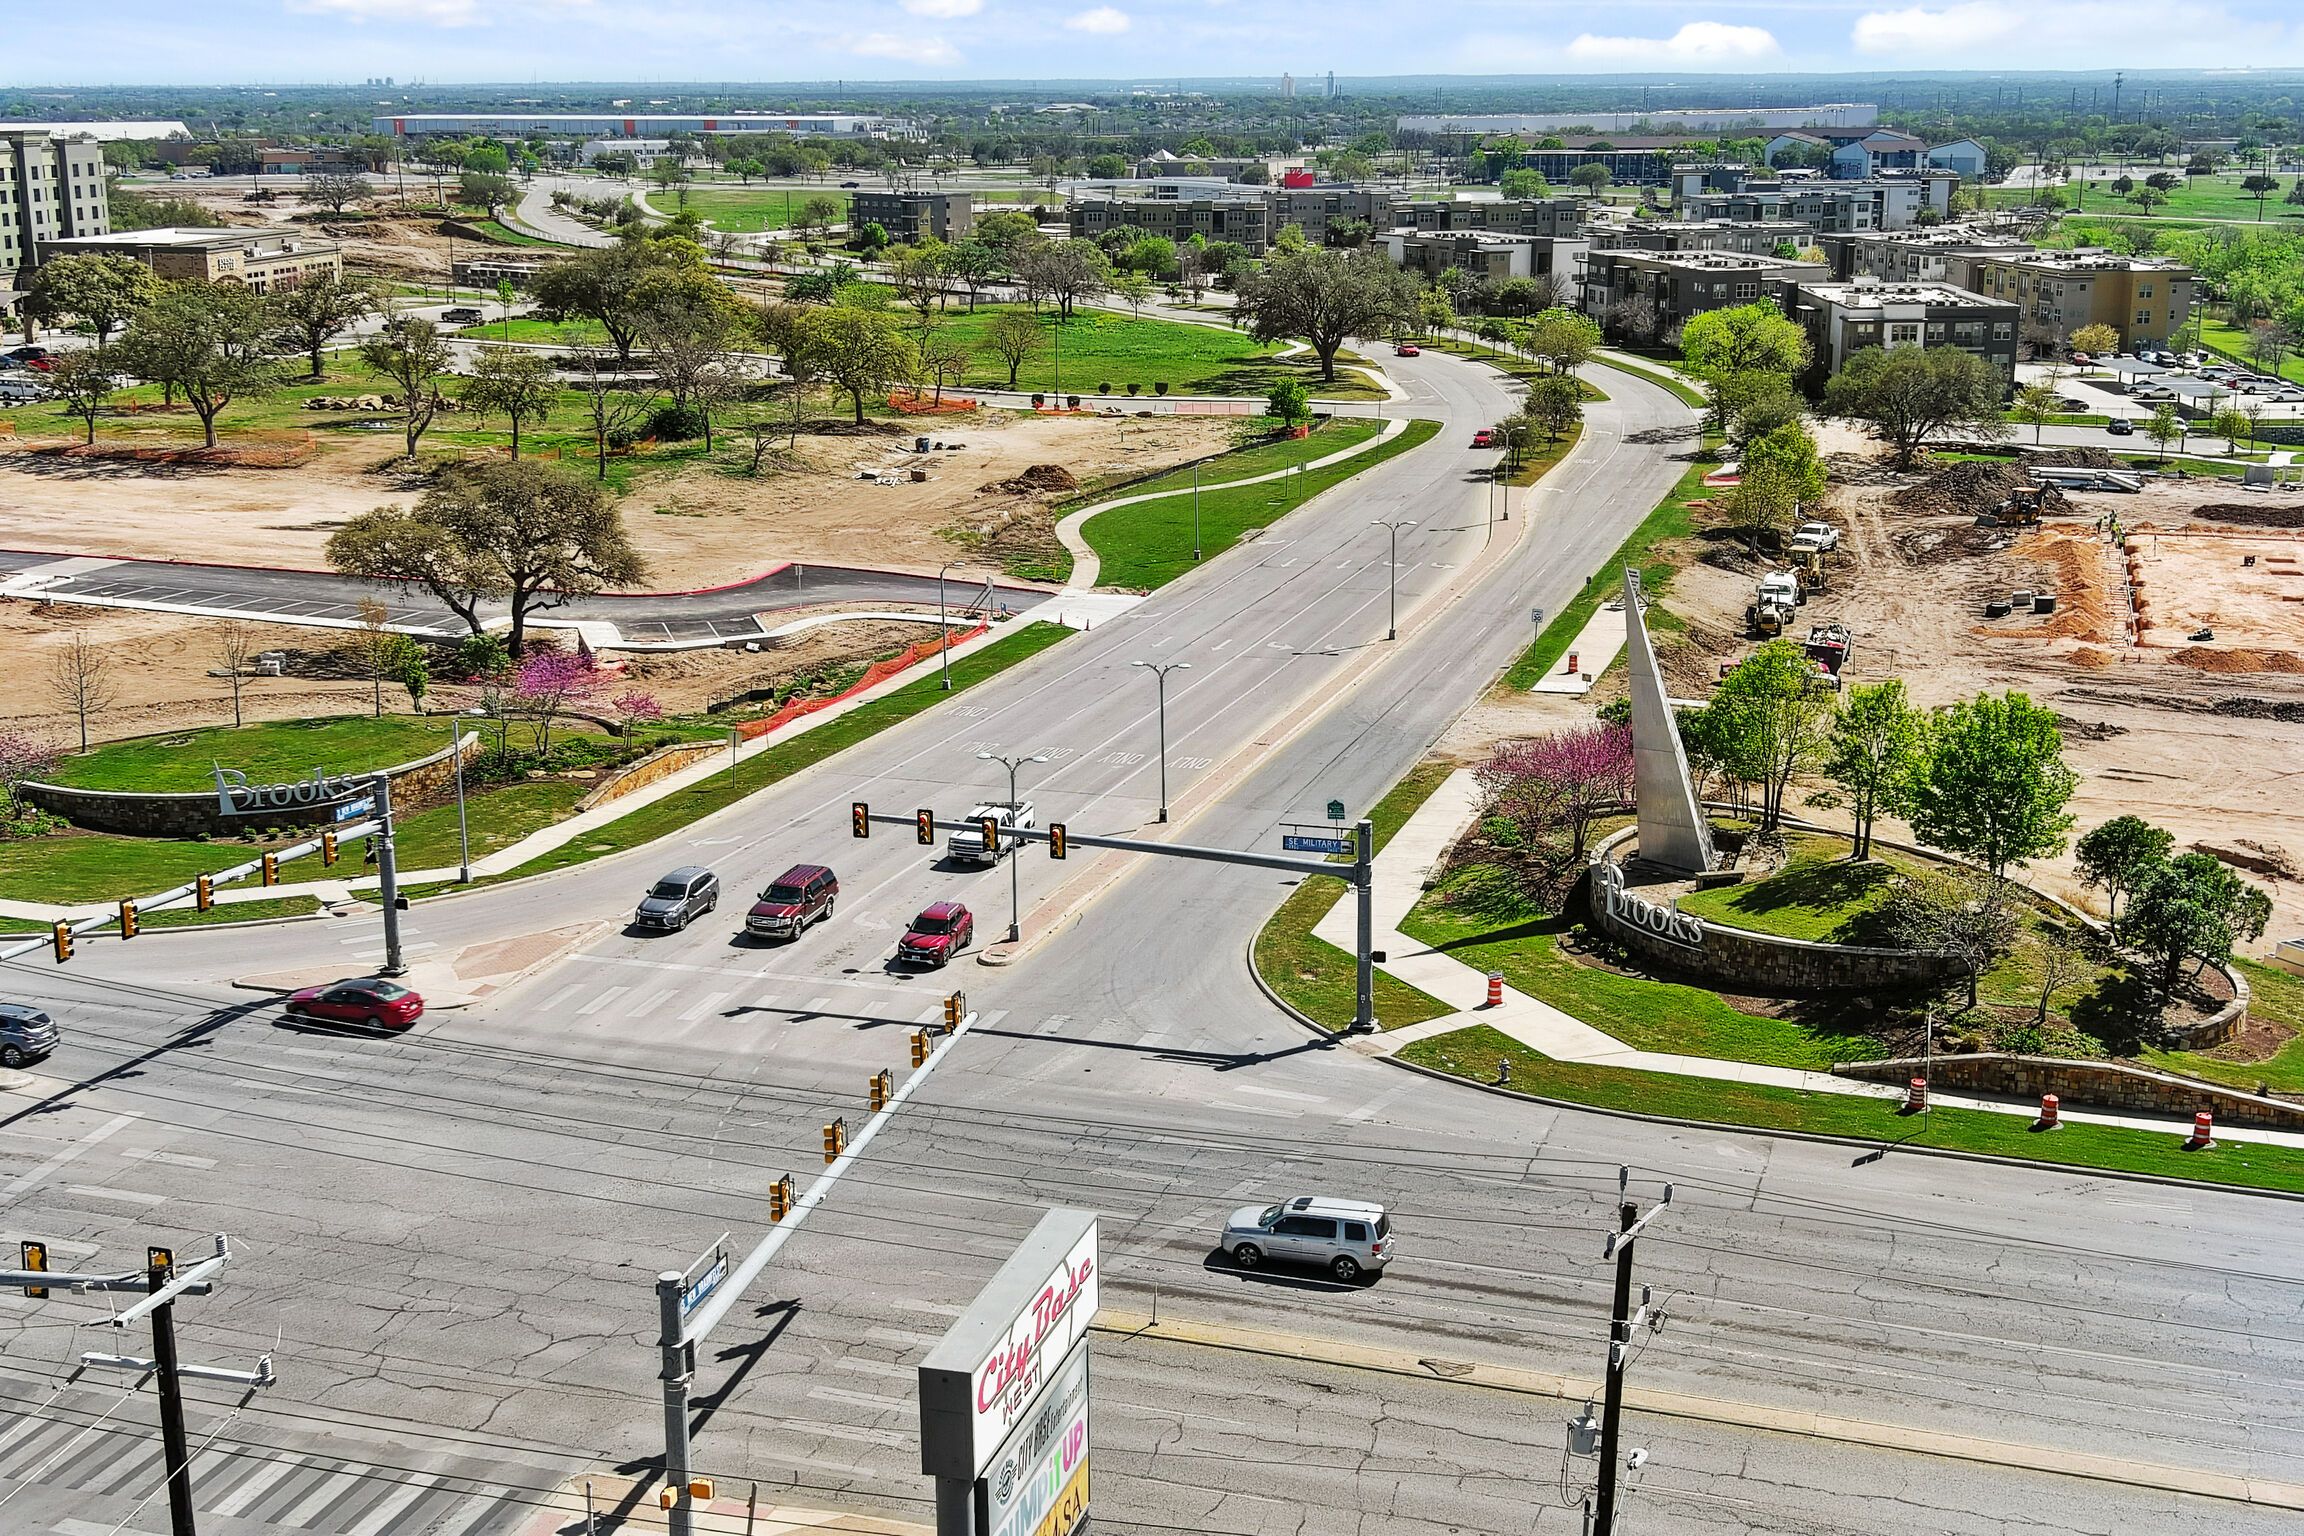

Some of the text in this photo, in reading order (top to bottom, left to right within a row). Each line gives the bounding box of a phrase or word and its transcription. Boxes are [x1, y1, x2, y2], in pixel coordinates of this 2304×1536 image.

[943, 705, 989, 717] ONLY
[1097, 751, 1145, 765] ONLY
[1164, 756, 1213, 770] ONLY
[1288, 837, 1299, 845] SE
[1302, 839, 1338, 848] MILITARY
[1605, 850, 1703, 943] Brooks
[978, 1257, 1094, 1415] City Base
[1002, 1363, 1039, 1425] WEST
[1017, 1429, 1034, 1480] CITY
